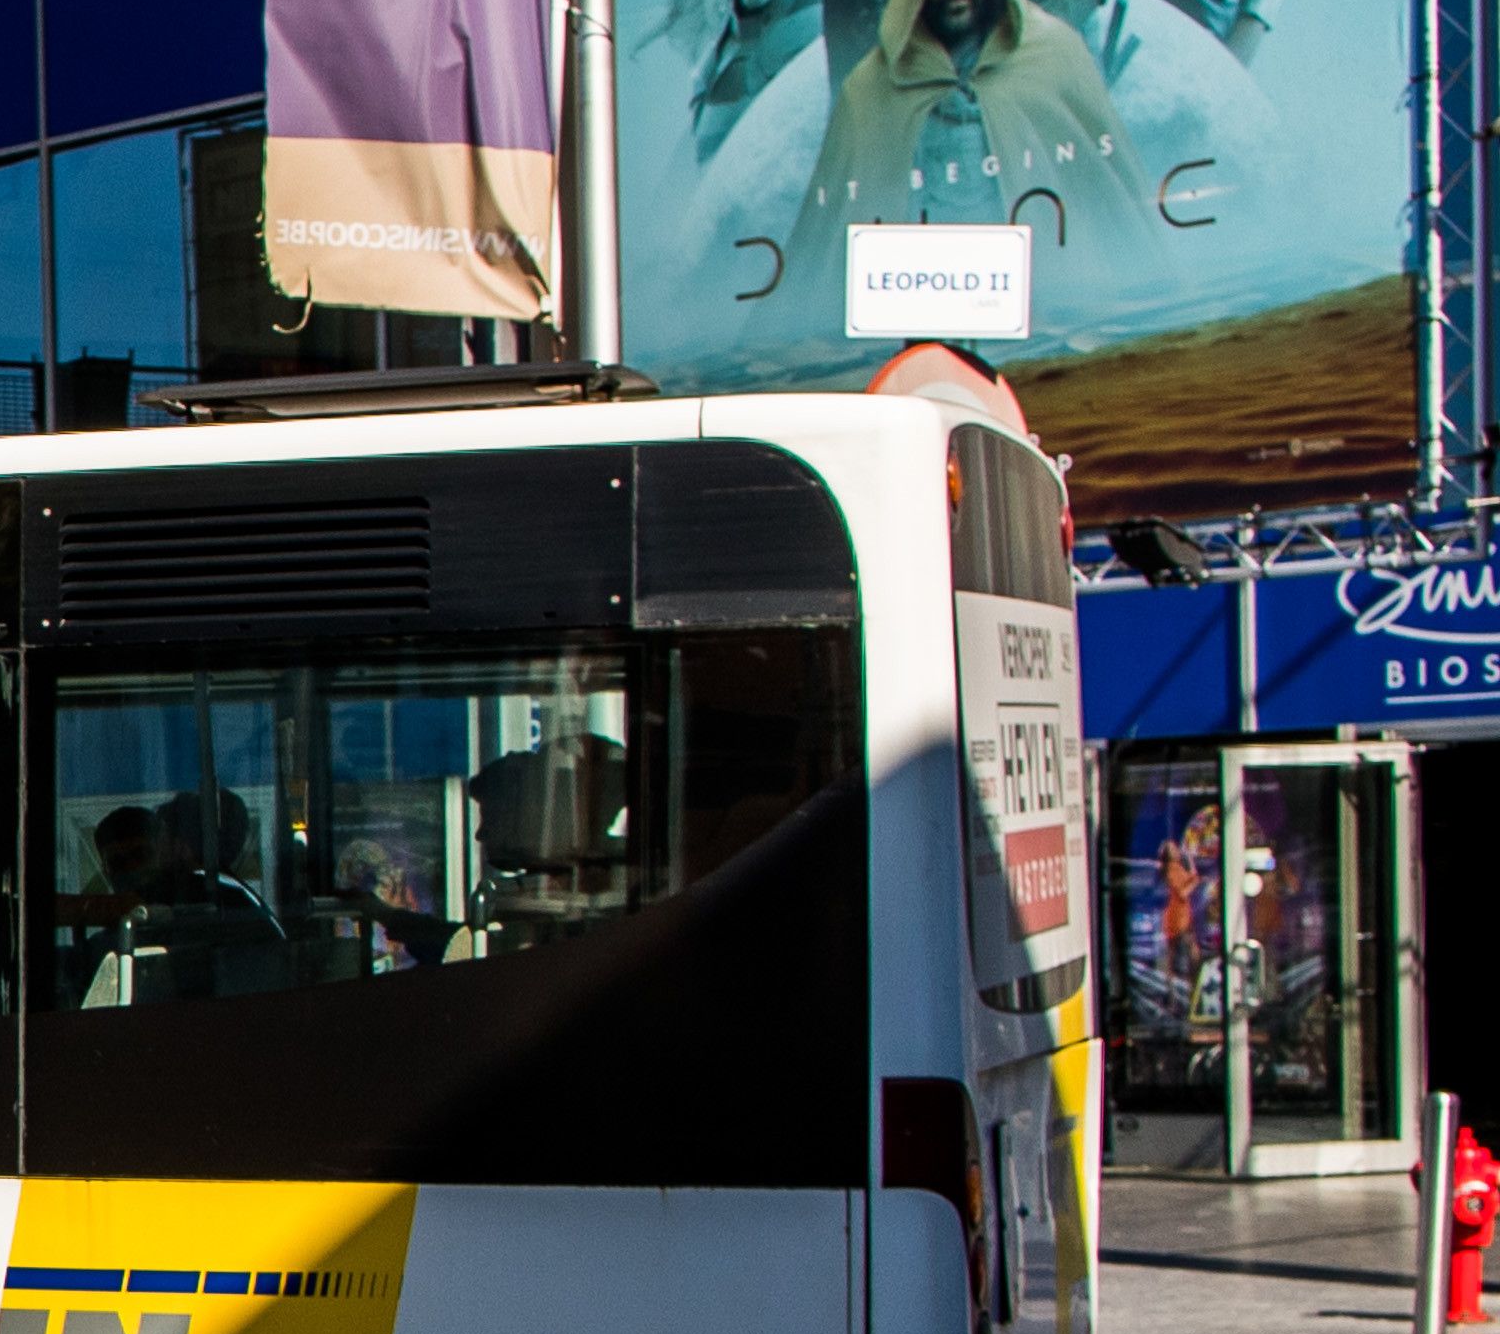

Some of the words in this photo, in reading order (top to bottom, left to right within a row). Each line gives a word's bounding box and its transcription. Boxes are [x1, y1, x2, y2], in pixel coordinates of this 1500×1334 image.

[817, 182, 859, 205] IT
[910, 134, 1114, 189] BEGINS
[867, 272, 980, 290] LEOPOLD
[990, 273, 1009, 290] II
[1000, 722, 1063, 813] HEYLEN
